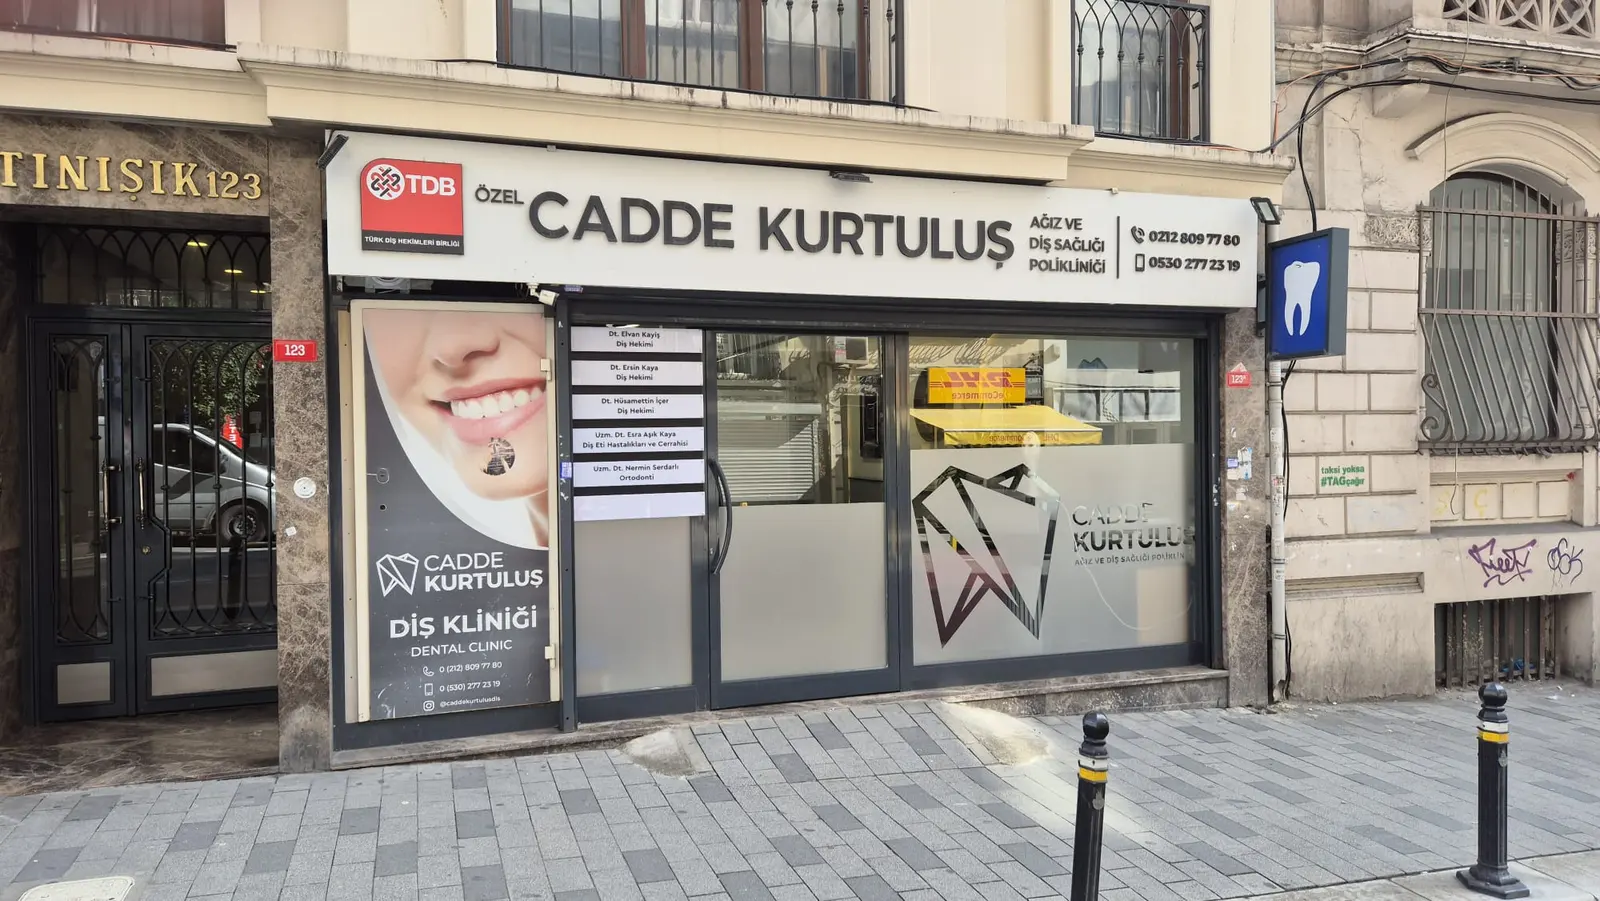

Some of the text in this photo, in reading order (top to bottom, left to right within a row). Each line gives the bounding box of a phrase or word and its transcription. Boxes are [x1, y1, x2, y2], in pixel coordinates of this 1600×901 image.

[206, 171, 262, 200] 123
[405, 173, 456, 196] TDB
[474, 183, 524, 205] ÖZEL
[528, 190, 1014, 270] CADDE KURTULUŞ
[1030, 213, 1083, 230] AĞIZ VE
[385, 236, 396, 244] DİŞ
[436, 239, 460, 247] BİRLİĞİ
[1029, 234, 1104, 254] DİŞ SAĞLIĞI
[1148, 230, 1240, 246] 0212 809 77 80
[1029, 256, 1106, 274] POLİKLİNİĞİ
[1148, 256, 1240, 272] 0530 277 23 19
[284, 343, 306, 356] 123
[1321, 464, 1365, 475] taksi yoksa
[1072, 502, 1154, 526] CADDE
[424, 552, 504, 572] CADDE
[1095, 556, 1104, 564] VE
[1106, 554, 1119, 564] DİŞ
[1121, 552, 1150, 563] SAĞLIĞI
[424, 569, 544, 593] KURTULUŞ
[390, 604, 537, 639] DİŞ KLİNİĞİ
[411, 640, 513, 657] DENTAL CLINIC
[446, 664, 463, 673] (212)
[446, 683, 465, 692] (530)
[440, 696, 501, 708] @caddekurtulusdis
